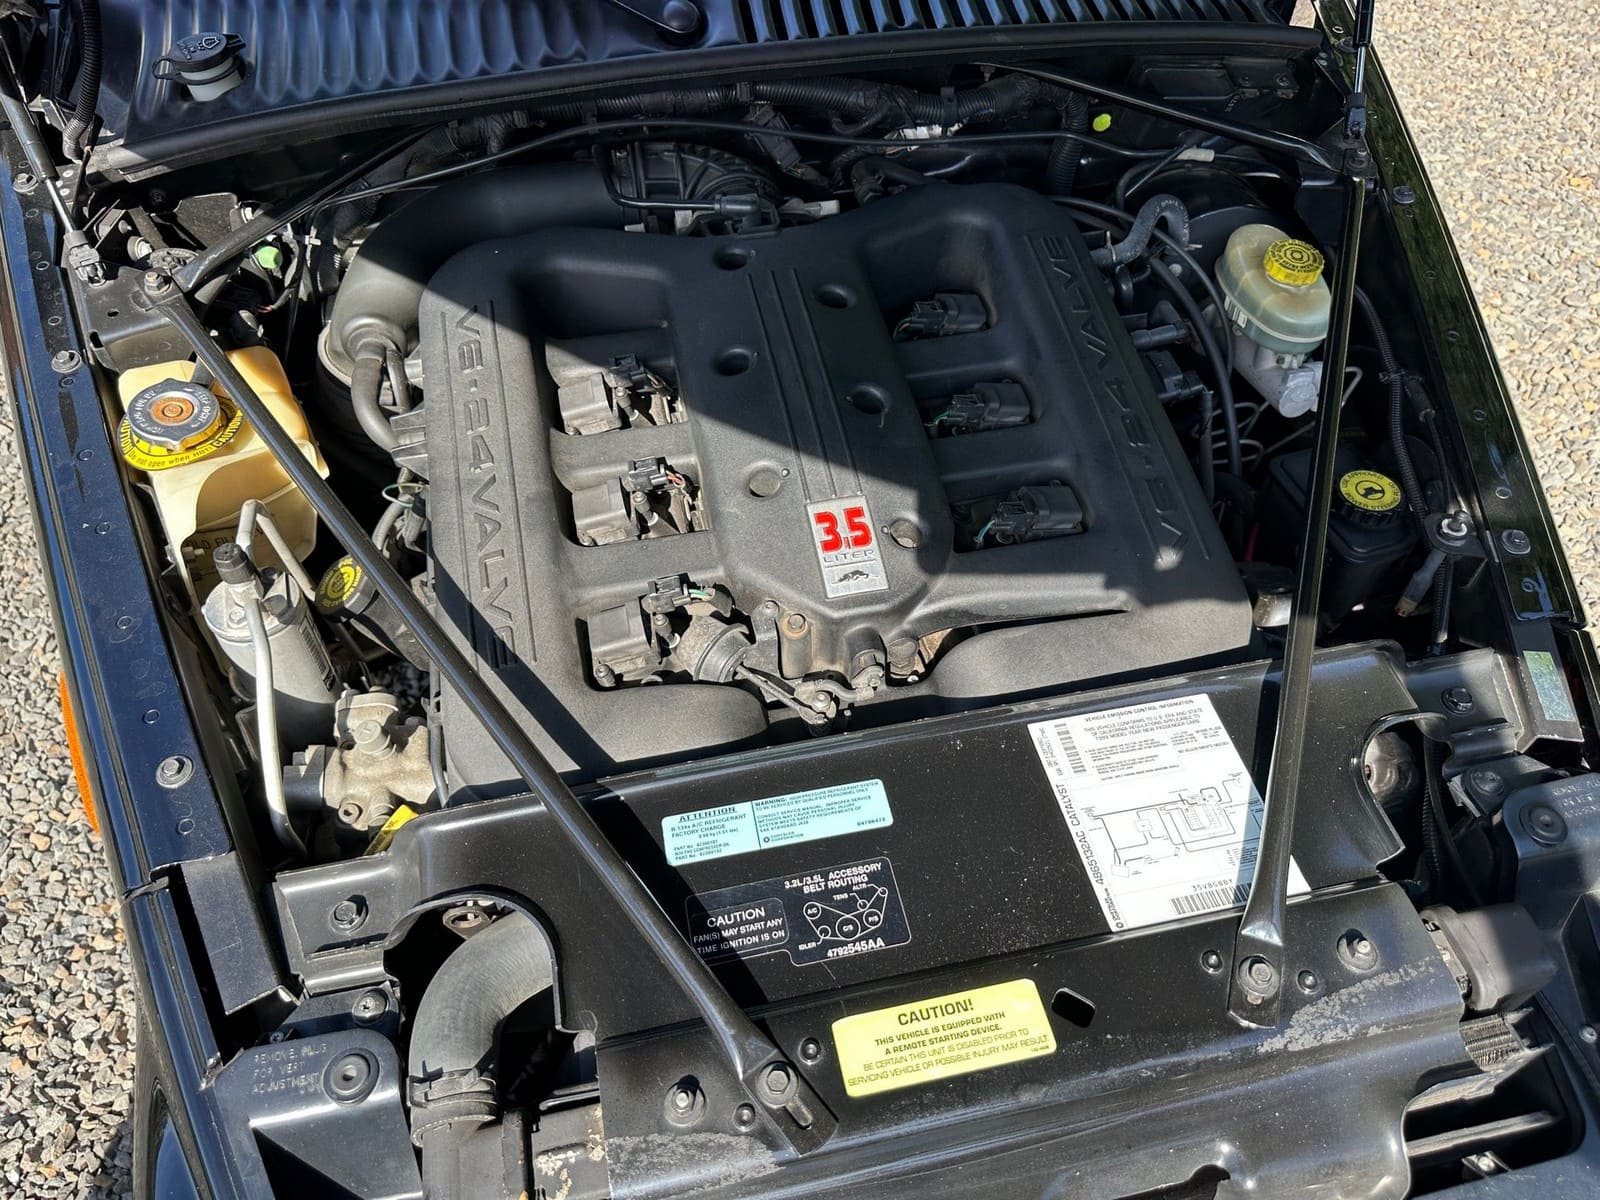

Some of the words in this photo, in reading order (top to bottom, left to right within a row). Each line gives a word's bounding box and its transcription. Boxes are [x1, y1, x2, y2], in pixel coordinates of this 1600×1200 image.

[813, 506, 873, 554] 3.5
[823, 549, 875, 564] LITER
[679, 807, 736, 822] ATTENTION
[1054, 783, 1081, 826] CATALYST
[784, 874, 825, 889] 3.2L/3.5L
[828, 862, 883, 880] ACCESSORY
[803, 882, 827, 894] BELT
[827, 874, 868, 889] ROUTING
[693, 931, 720, 943] FAN(S)
[721, 927, 739, 937] MAY
[739, 921, 766, 933] START
[766, 918, 783, 927] ANY
[706, 907, 766, 928] CAUTION
[697, 944, 718, 955] TIME
[720, 935, 760, 950] IGNITION
[761, 933, 769, 941] IS
[771, 930, 786, 939] ON
[826, 937, 885, 959] 4792545AA
[896, 999, 974, 1026] CAUTION!
[875, 1036, 894, 1046] THIS
[896, 1028, 930, 1041] VEHICLE
[931, 1026, 940, 1034] IS
[941, 1017, 982, 1031] EQUIPPED
[983, 1012, 1006, 1022] WITH
[892, 1040, 927, 1053] REMOTE
[928, 1031, 969, 1045] STARTING
[970, 1023, 1002, 1036] DEVICE.
[863, 1063, 874, 1072] BE
[875, 1055, 908, 1069] CERTAIN
[909, 1051, 927, 1061] THIS
[928, 1047, 946, 1057] UNIT
[956, 1036, 994, 1051] DISABLED
[994, 1031, 1017, 1042] PRIOR
[1018, 1028, 1029, 1036] TO
[848, 1071, 889, 1086] SERVICING
[889, 1063, 922, 1077] VEHICLE
[922, 1060, 934, 1069] OR
[935, 1052, 971, 1066] POSSIBLE
[972, 1046, 1001, 1058] INJURY
[1001, 1042, 1019, 1051] MAY
